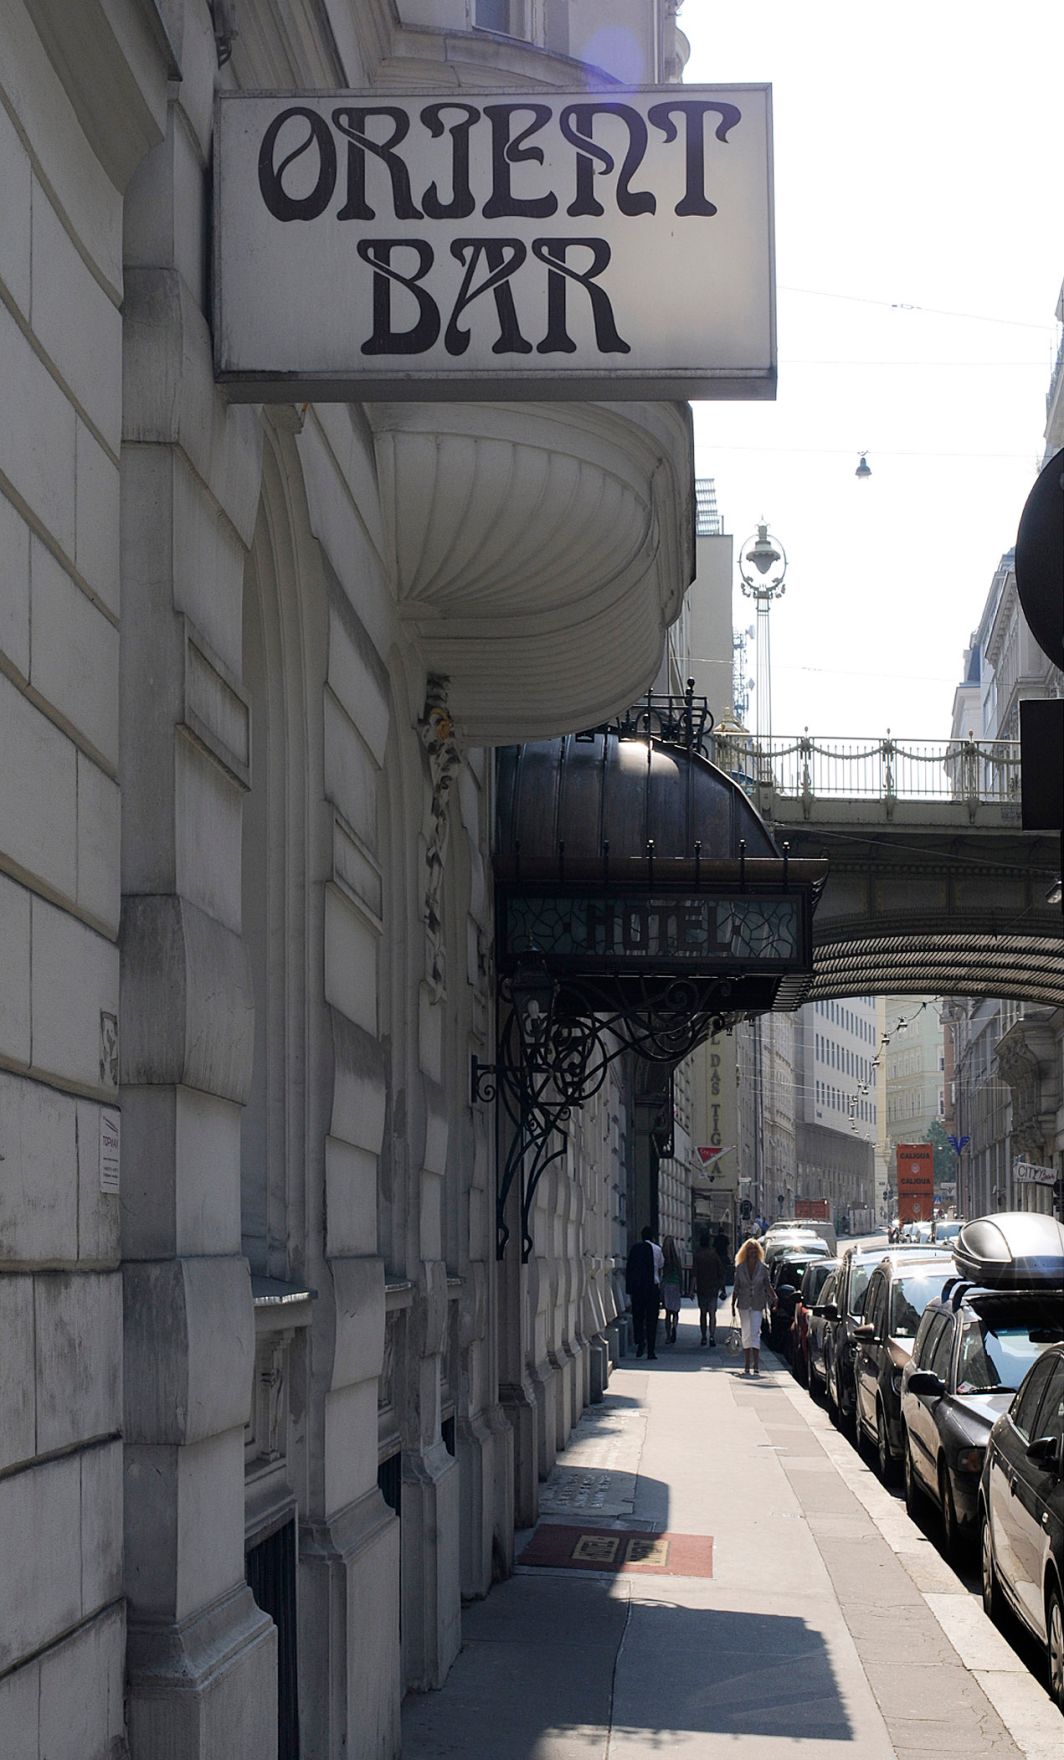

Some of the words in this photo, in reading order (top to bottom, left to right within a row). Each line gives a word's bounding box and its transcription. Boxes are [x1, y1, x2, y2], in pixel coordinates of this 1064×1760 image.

[258, 102, 742, 222] ORIENT
[356, 237, 631, 357] BAR
[586, 902, 732, 954] HOTEL
[710, 1054, 721, 1096] DAS
[710, 1104, 721, 1175] TIGA
